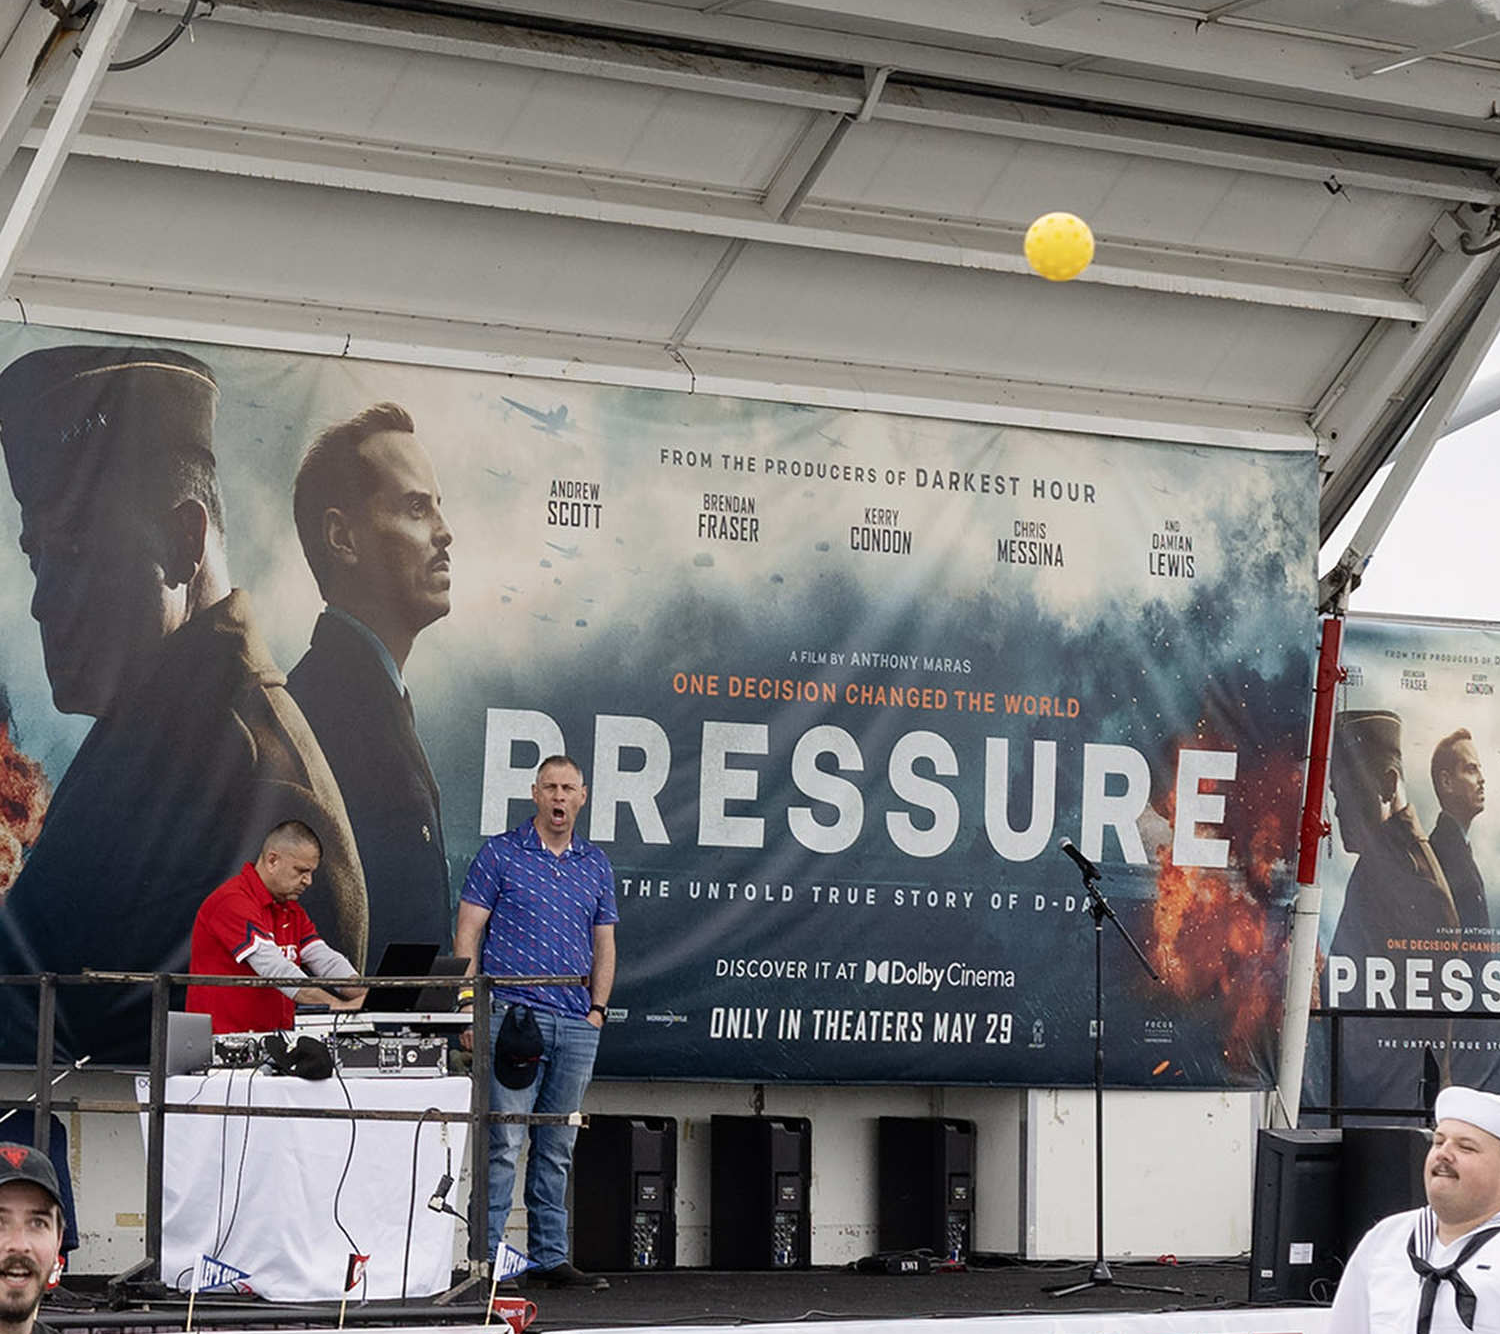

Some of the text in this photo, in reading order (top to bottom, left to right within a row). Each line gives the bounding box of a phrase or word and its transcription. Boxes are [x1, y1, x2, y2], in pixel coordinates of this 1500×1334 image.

[660, 449, 1097, 504] FROM THE PRODUCERS OF DARKEST HOUR
[550, 480, 600, 501] ANDREW
[703, 493, 756, 515] BRENDAN
[547, 500, 602, 529] SCOTT
[698, 513, 759, 542] FRASER
[864, 507, 899, 526] KERRY
[1164, 520, 1180, 533] AND
[850, 526, 912, 555] CONDON
[1013, 520, 1046, 540] CHRIS
[1152, 533, 1192, 552] DAMIAN
[997, 538, 1064, 567] MESSINA
[1149, 552, 1195, 578] LEWIS
[789, 651, 972, 674] A FILM BY ANTHONY MARAS
[673, 672, 1080, 719] ONE DECISION CHANGED THE WORLD
[479, 707, 1239, 870] PRESSURE
[621, 879, 1107, 913] THE UNTOLD TRUE STORY OF D-DA
[1387, 939, 1407, 950] ONE
[1410, 939, 1458, 952] DECISION
[715, 958, 1015, 993] DISCOVER IT AT Dolby Cinema
[709, 1007, 1013, 1045] ONLY IN THEATERS MAY 29
[1378, 1039, 1397, 1048] THE
[1452, 1041, 1480, 1050] TRUE
